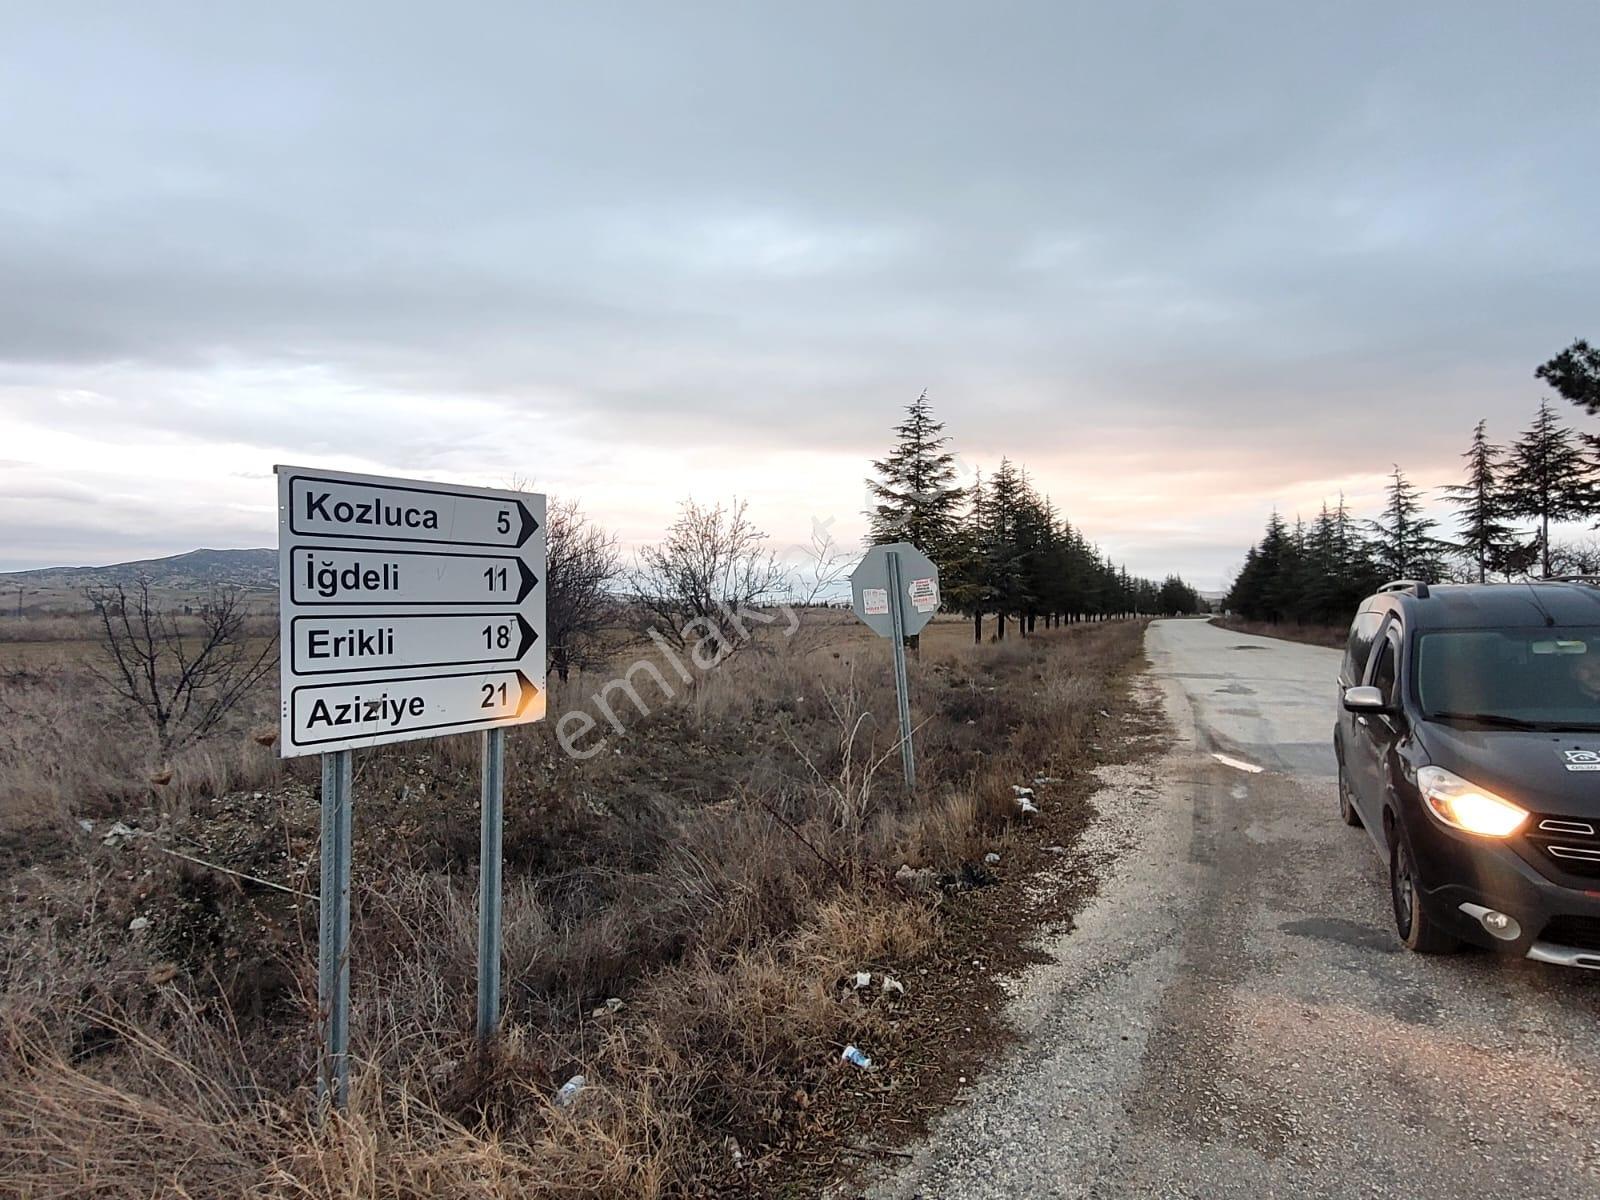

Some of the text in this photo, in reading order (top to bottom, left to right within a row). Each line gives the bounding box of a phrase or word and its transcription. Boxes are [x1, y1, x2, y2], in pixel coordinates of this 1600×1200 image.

[306, 491, 511, 534] Kozluca 5
[306, 553, 508, 597] İğdeli 11
[307, 625, 510, 659] Erikli 18
[306, 682, 508, 729] Aziziye 21
